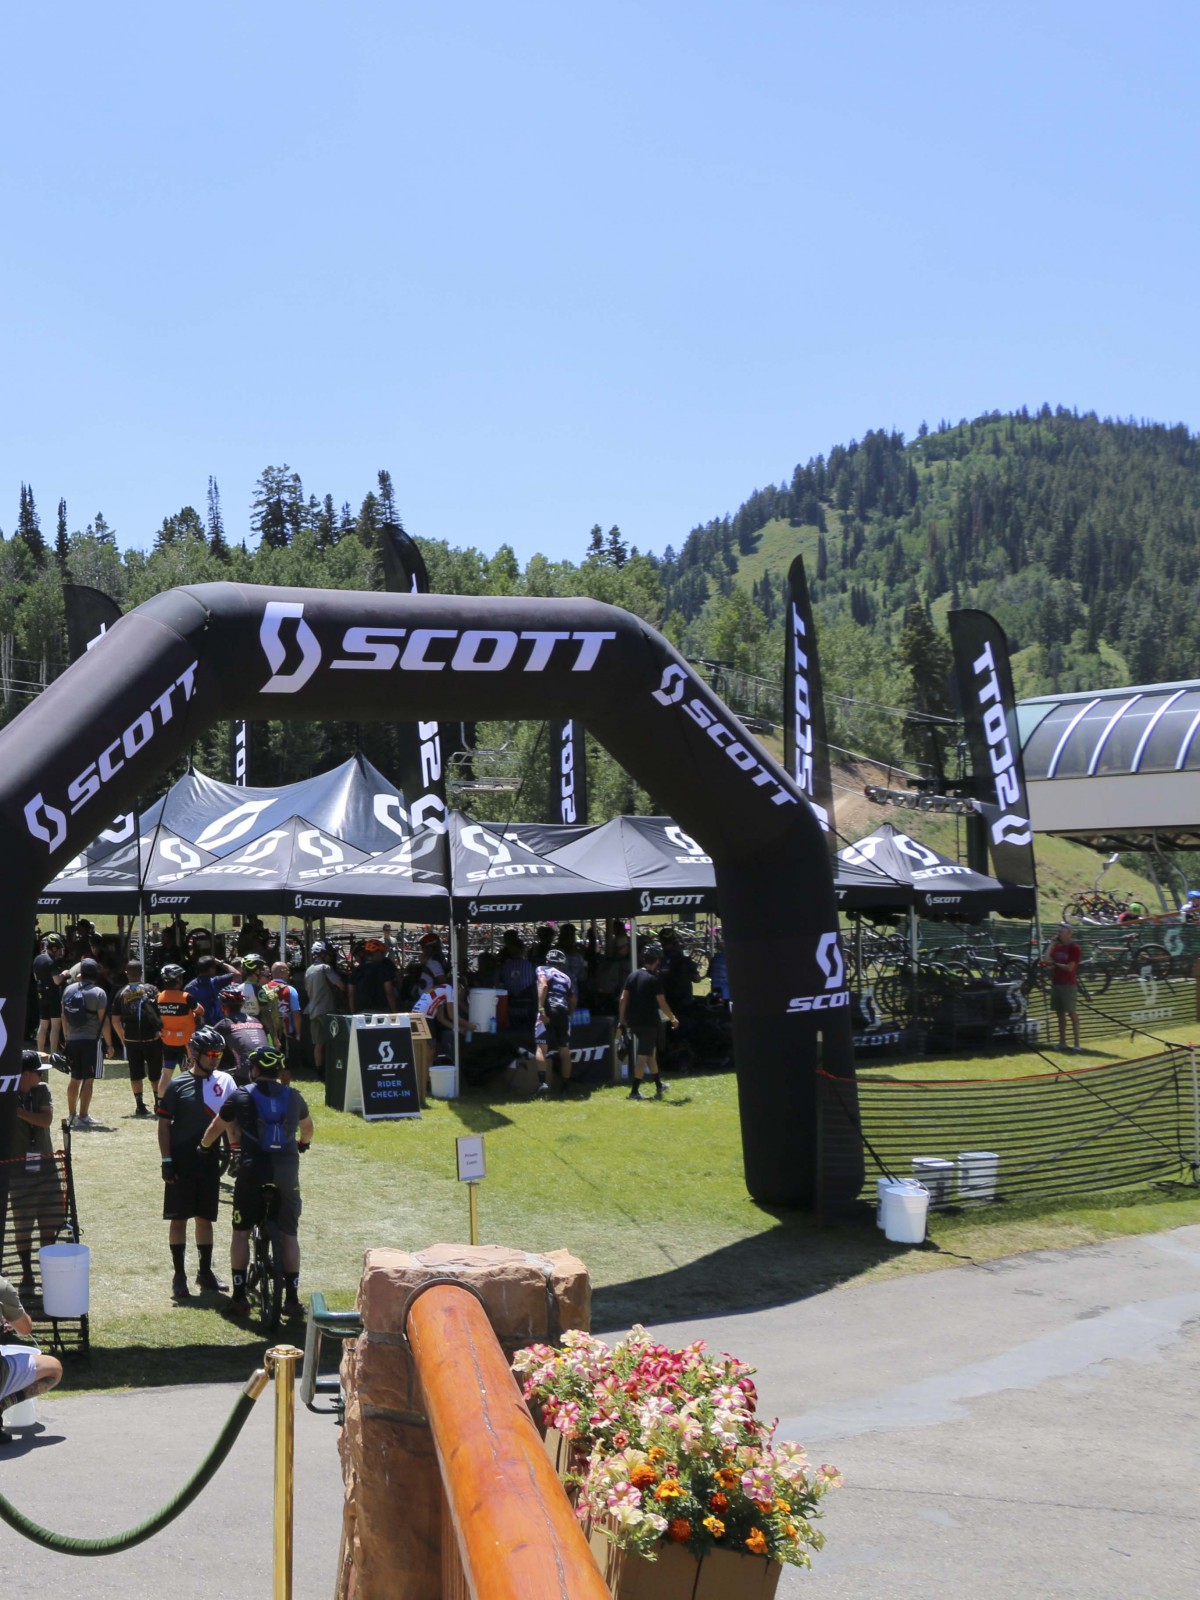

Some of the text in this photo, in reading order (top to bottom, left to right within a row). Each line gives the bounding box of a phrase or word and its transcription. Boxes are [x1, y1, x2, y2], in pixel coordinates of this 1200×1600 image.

[329, 627, 616, 671] SCOTT
[68, 659, 198, 815] SCOTT
[681, 698, 798, 806] SCOTT
[196, 864, 279, 877] SCOTT
[345, 864, 444, 880] SCOTT
[466, 864, 556, 882] SCOTT
[910, 865, 973, 880] SCOTT
[157, 896, 190, 904] SCOTT
[302, 898, 342, 908] SCOTT
[651, 894, 705, 906] SCOTT
[932, 896, 962, 904] SCOTT
[478, 903, 523, 912] SCOTT
[367, 1062, 408, 1071] SCOTT
[370, 1090, 411, 1098] CHECK-IN
